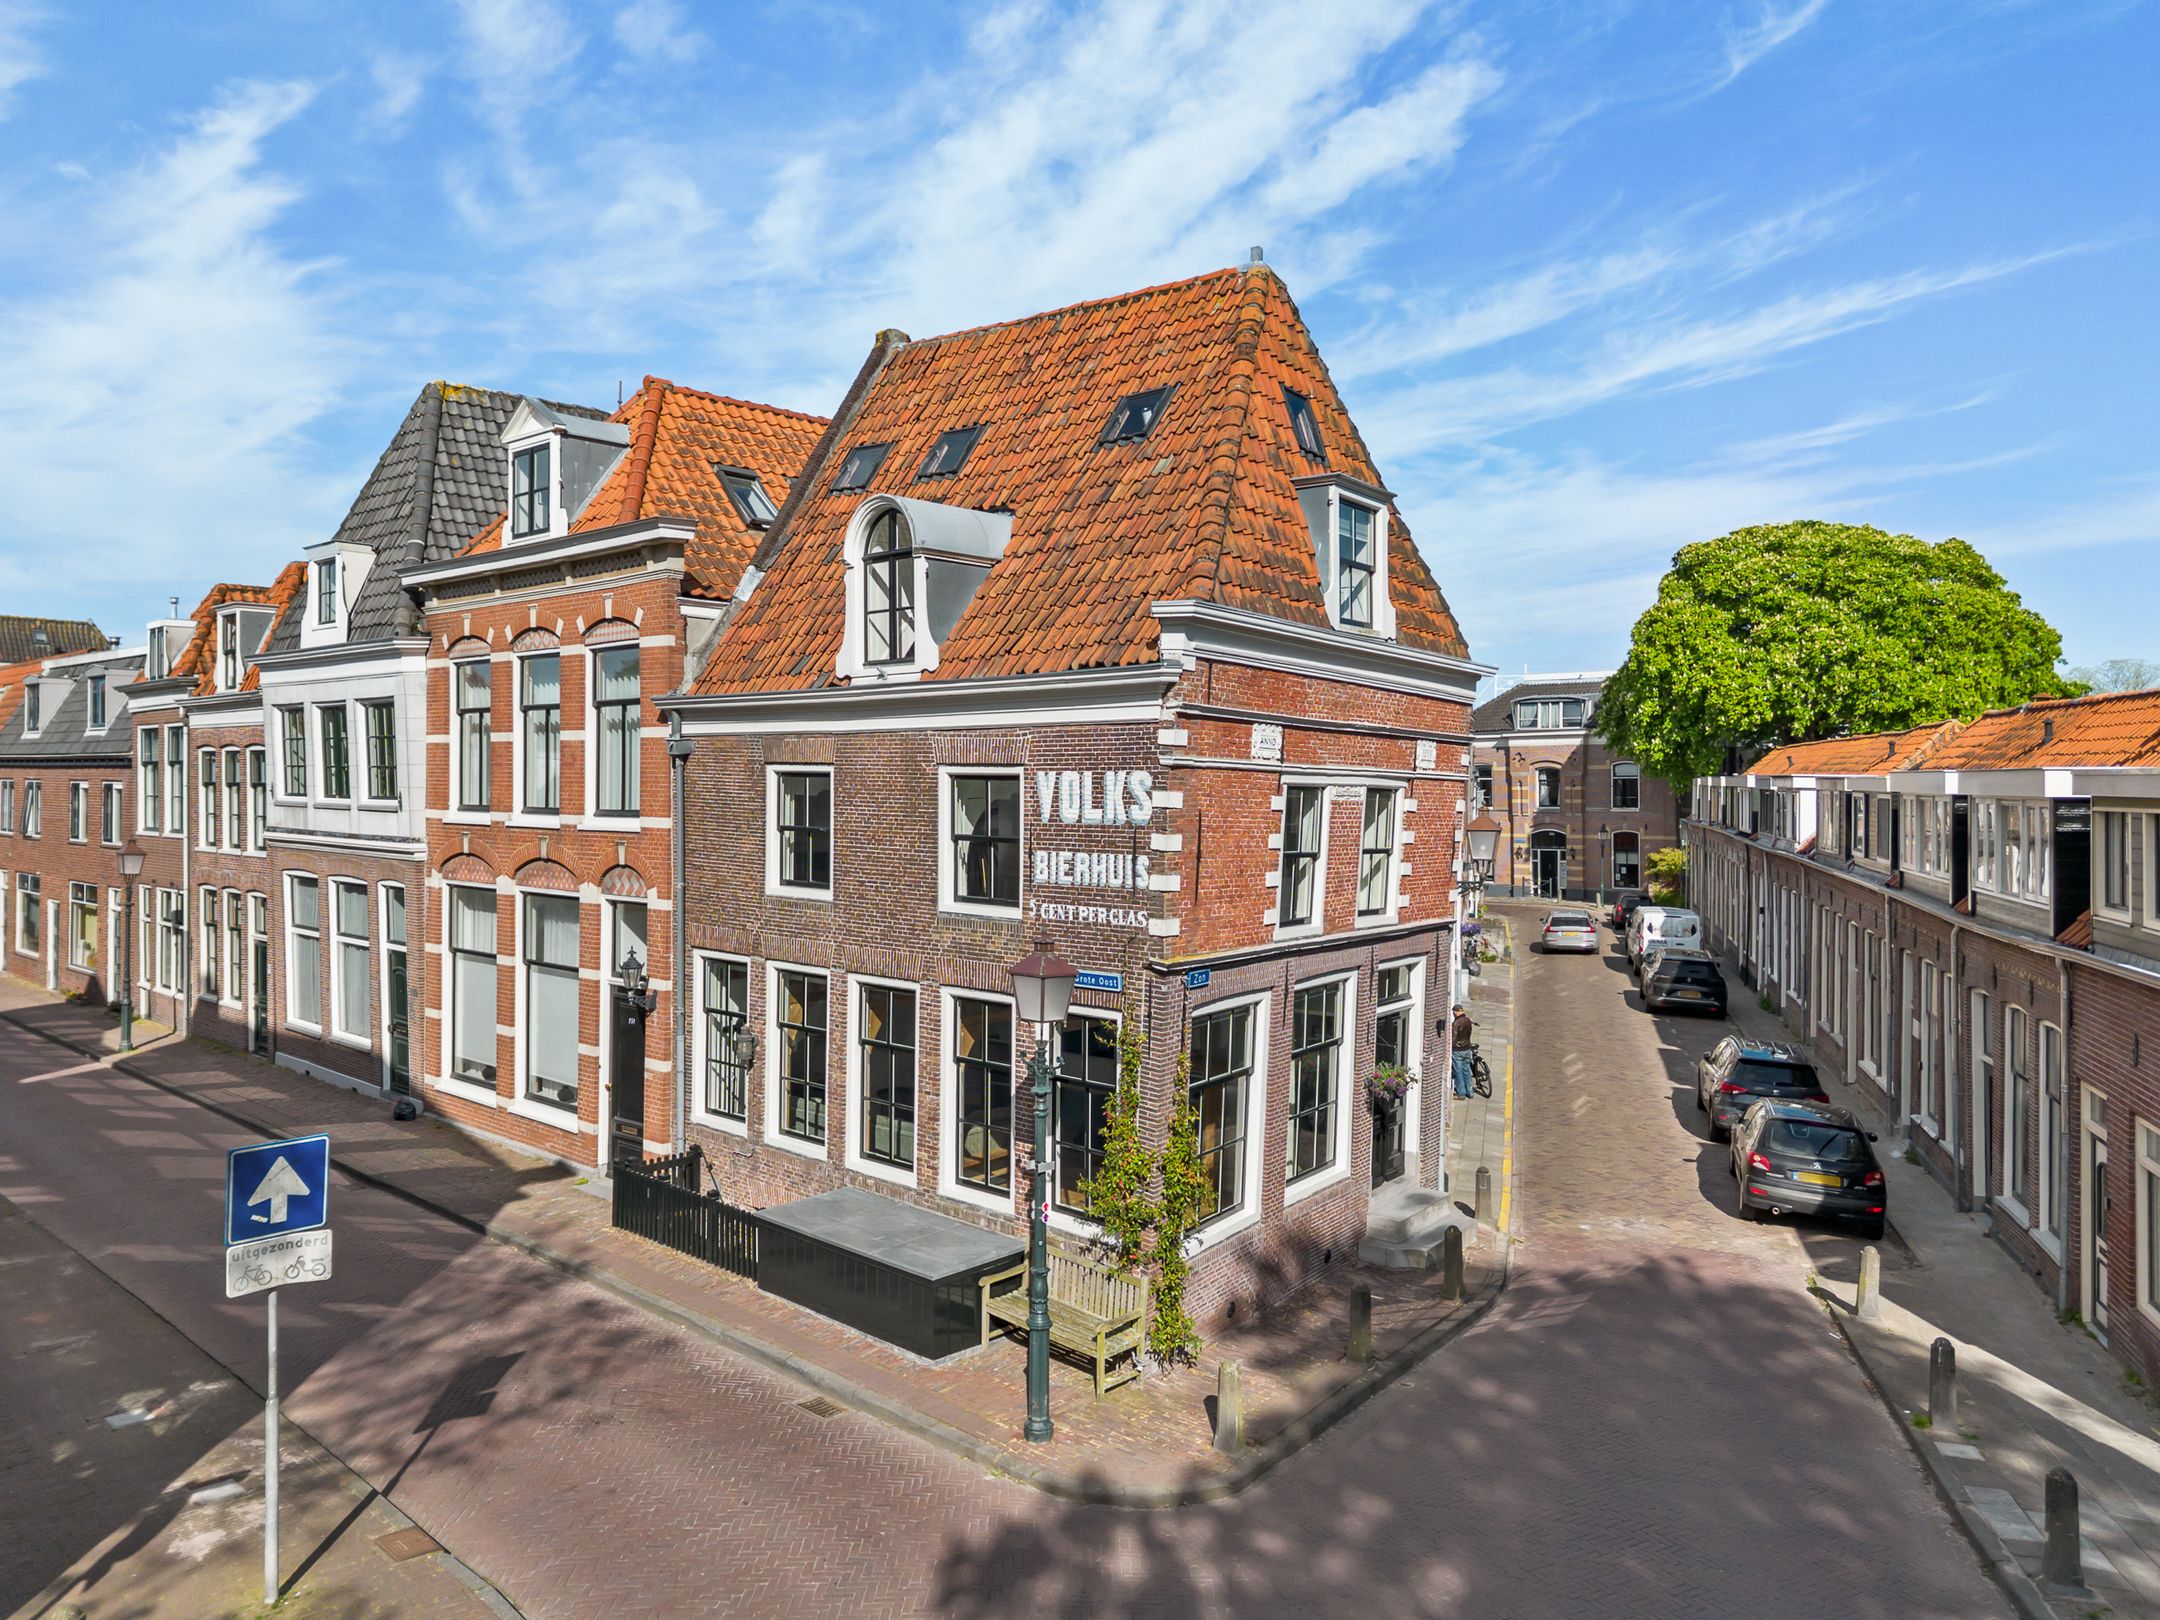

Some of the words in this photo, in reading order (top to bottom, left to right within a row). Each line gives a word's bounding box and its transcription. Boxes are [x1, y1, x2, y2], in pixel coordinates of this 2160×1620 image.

[1260, 736, 1277, 747] ANNO
[1036, 770, 1153, 825] VOLKS
[1033, 850, 1150, 889] BIERHUIS
[1041, 903, 1077, 921] CENT
[1078, 905, 1107, 924] PER
[1098, 976, 1118, 987] Oost
[1193, 973, 1207, 984] Zon
[232, 1235, 328, 1262] uitgezonderd
